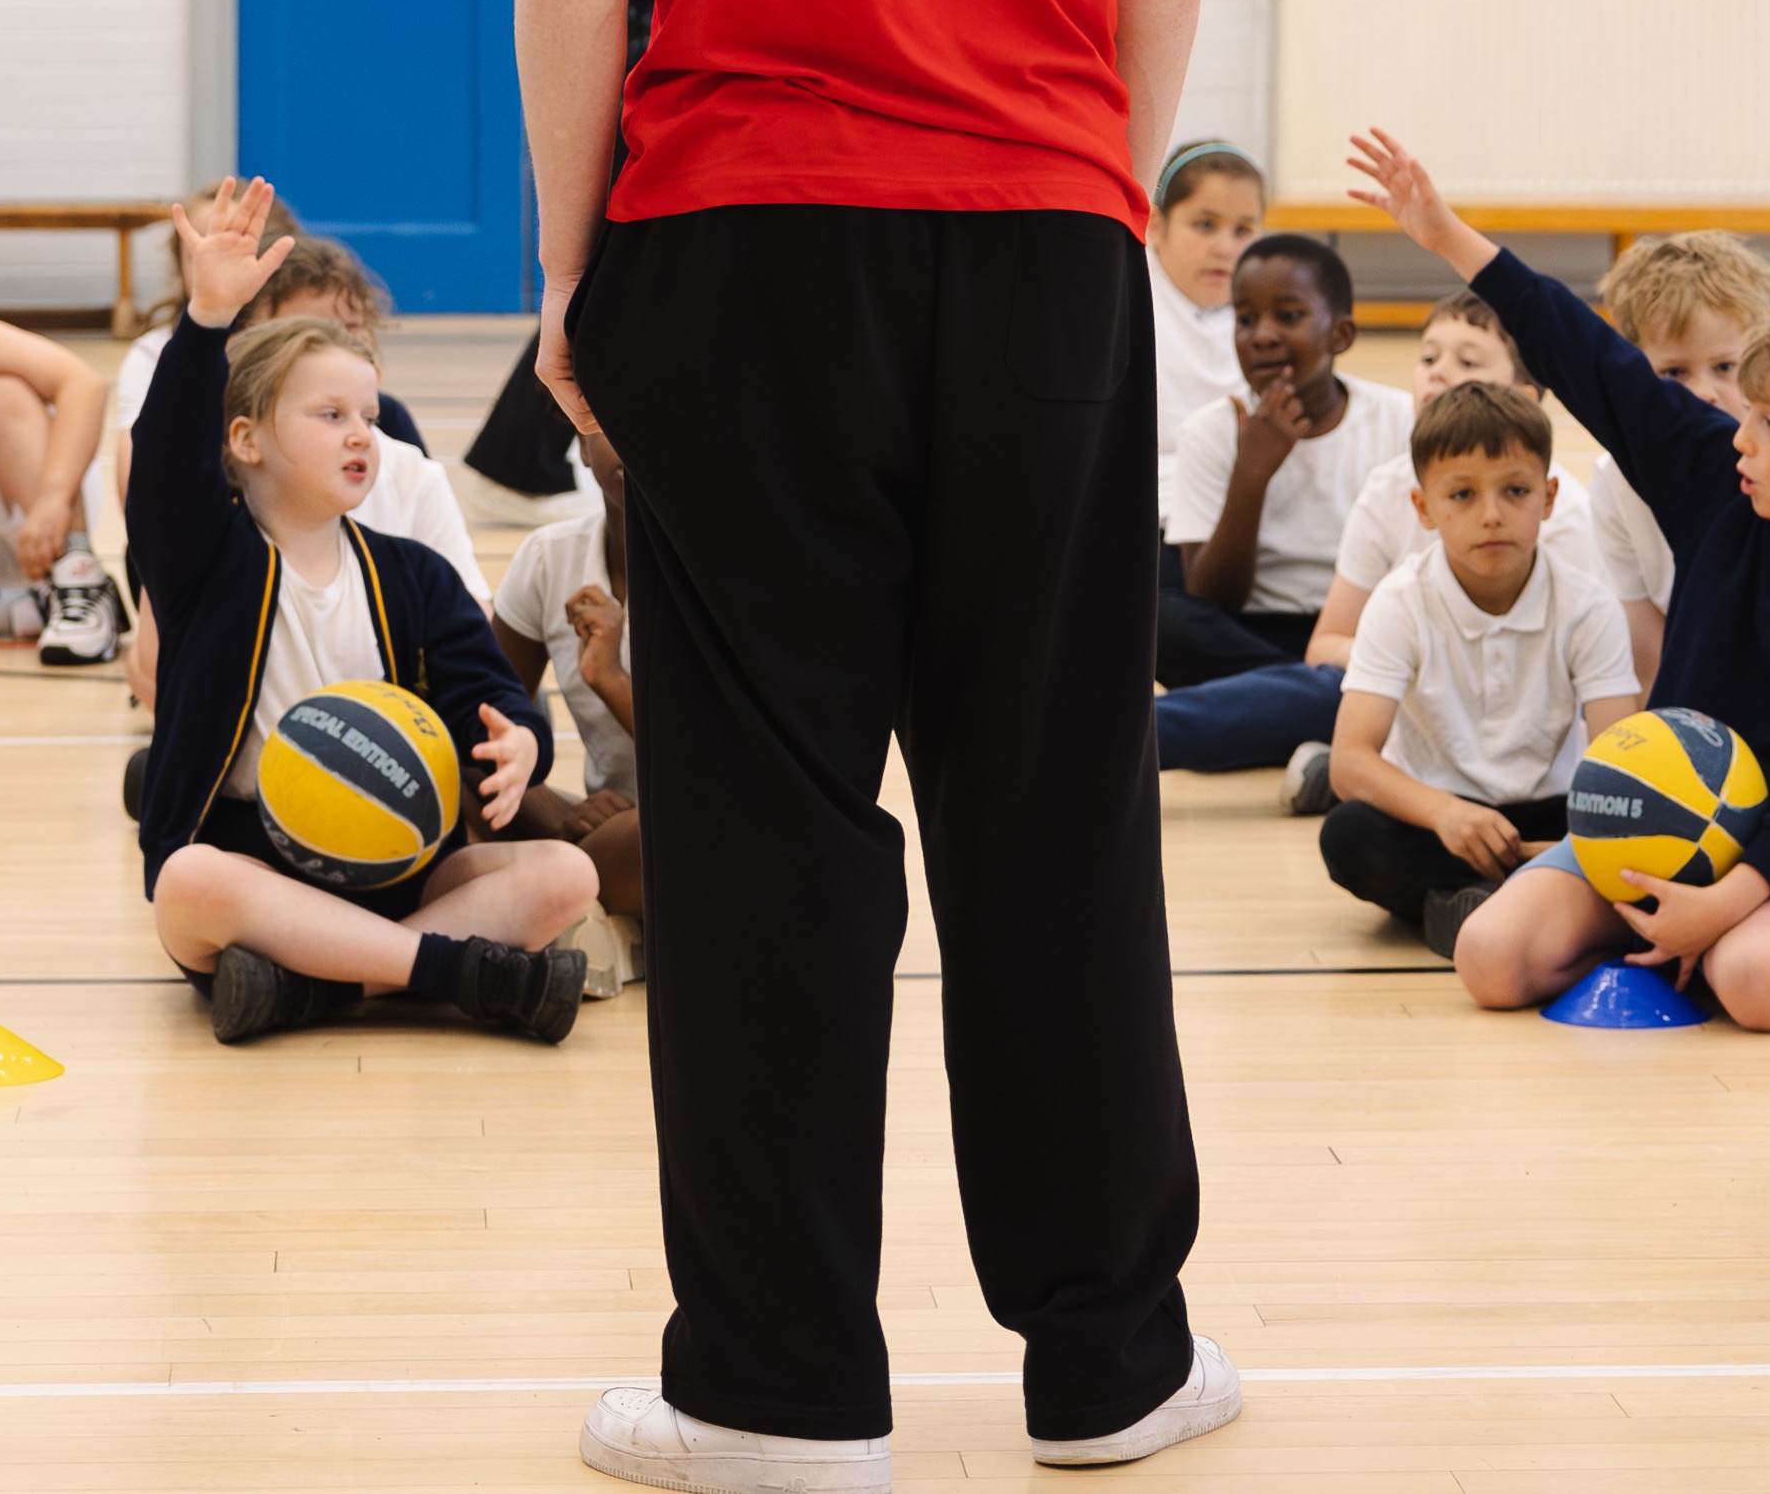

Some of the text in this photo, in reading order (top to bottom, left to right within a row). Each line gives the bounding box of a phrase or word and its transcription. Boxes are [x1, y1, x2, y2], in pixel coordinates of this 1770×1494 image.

[340, 726, 411, 790] EDITION
[402, 779, 420, 799] 5
[1630, 798, 1644, 819] 5
